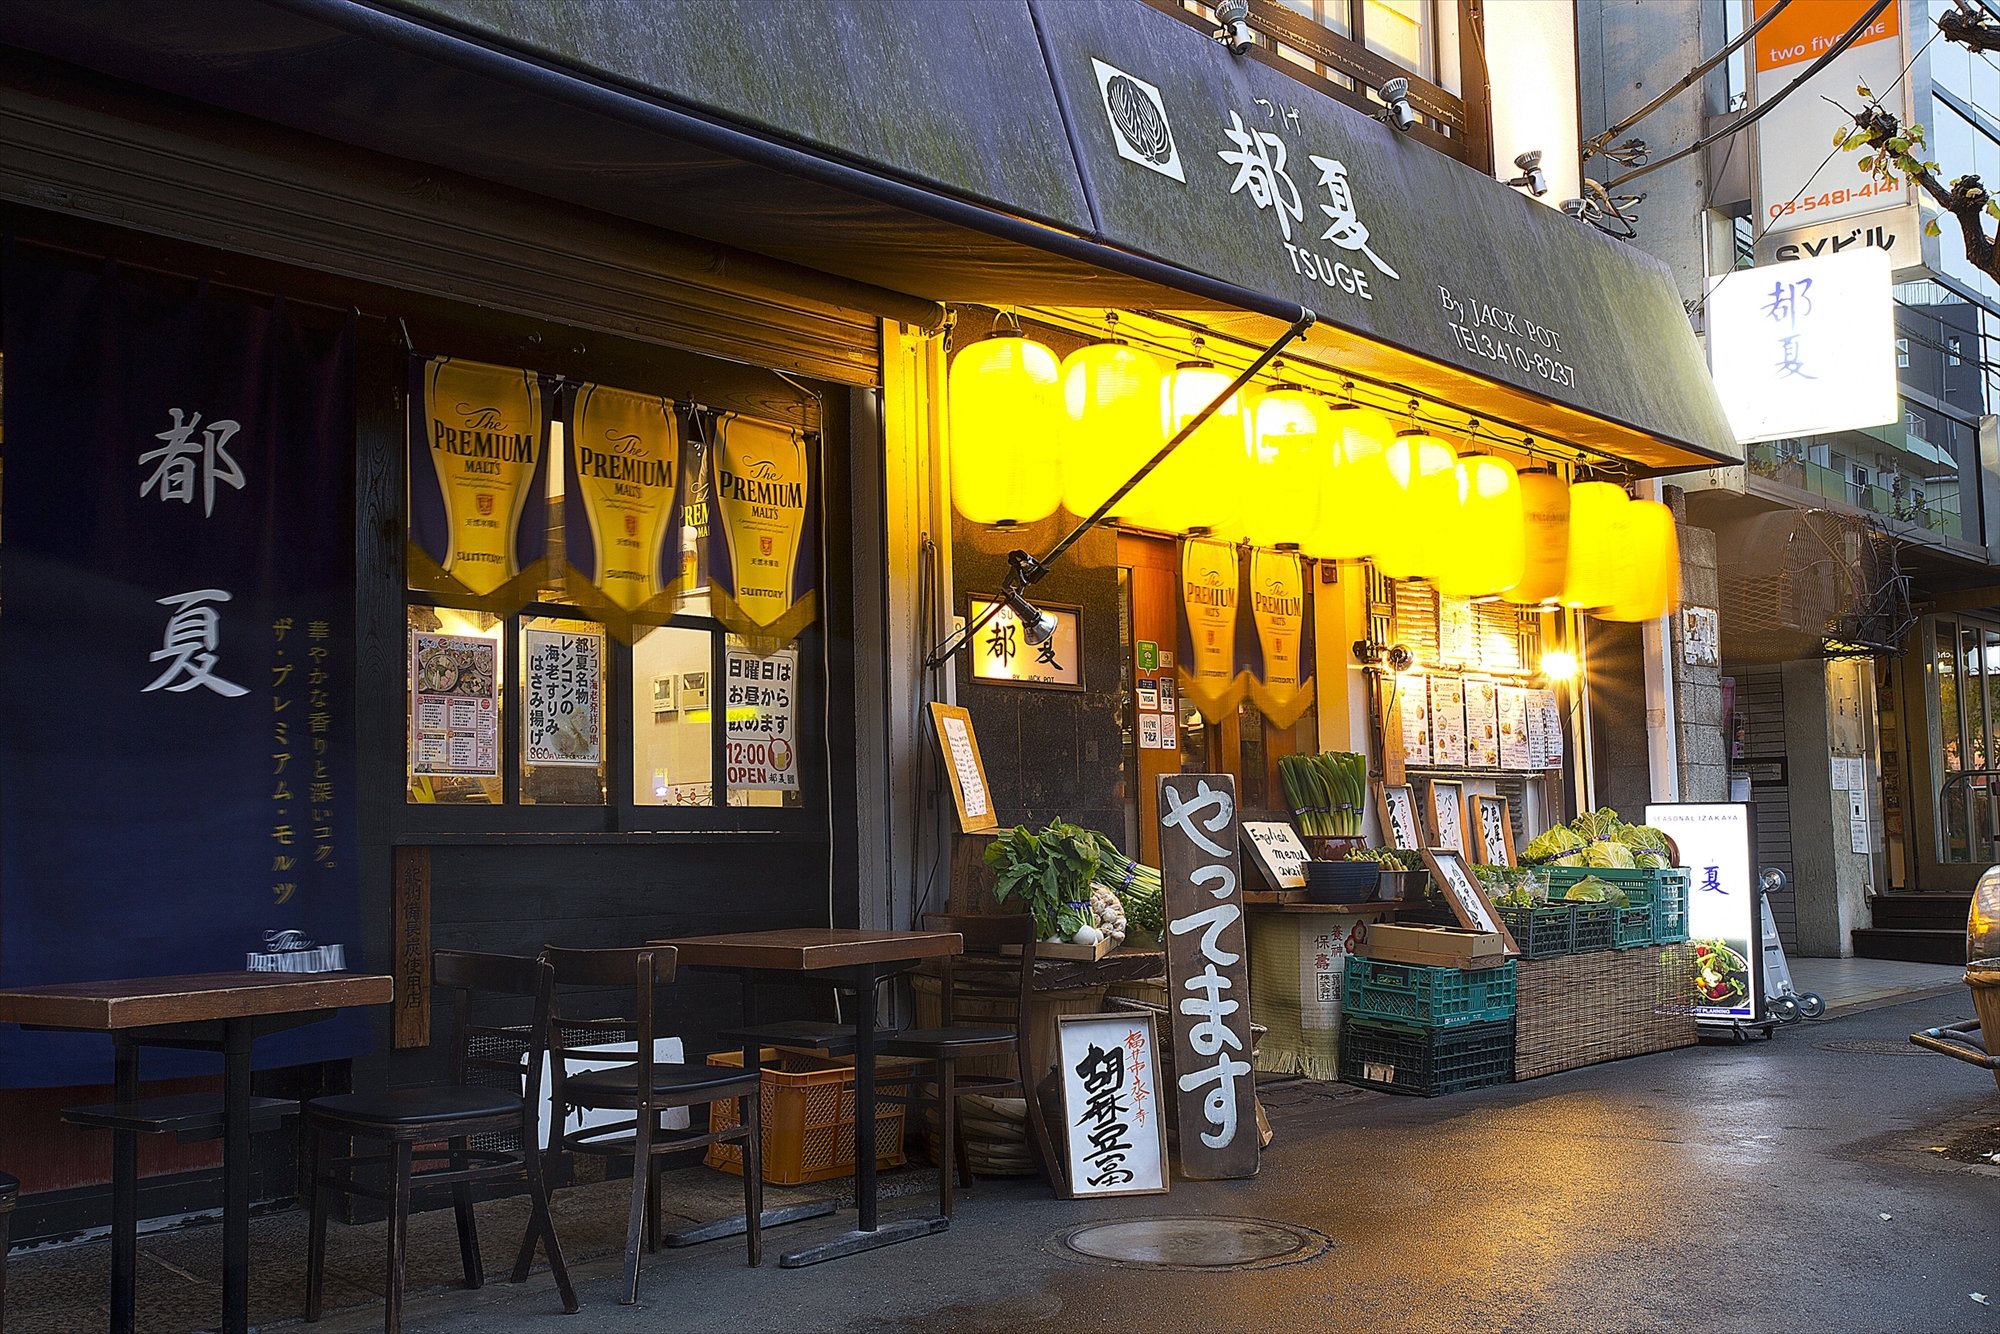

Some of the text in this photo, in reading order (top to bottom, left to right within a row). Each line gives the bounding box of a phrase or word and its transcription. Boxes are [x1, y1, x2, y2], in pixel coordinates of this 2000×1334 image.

[1769, 45, 1805, 62] two
[1857, 22, 1885, 41] ne
[1253, 97, 1302, 137] つげ
[1217, 109, 1400, 280] 都夏
[1769, 176, 1899, 218] 03-5481-4141
[1283, 246, 1373, 301] TSUGE
[1437, 290, 1573, 358] By JACK POT
[1760, 276, 1819, 380] 都夏
[1447, 326, 1586, 388] TEL3410-8237
[456, 403, 509, 431] The
[433, 418, 535, 464] PREMIUM
[605, 429, 651, 458] The
[580, 446, 674, 488] PREMIUM
[743, 455, 783, 481] The
[720, 470, 804, 508] PREMIUM
[138, 407, 251, 698] 都夏
[740, 587, 784, 599] SUNTORY
[1186, 582, 1237, 609] PREMIUM
[1200, 567, 1225, 587] The
[1265, 577, 1290, 598] The
[1255, 591, 1302, 617] PREMIUM
[560, 635, 574, 716] レンコンの
[575, 637, 589, 706] 都夏名物
[729, 658, 792, 681] 日曜日は
[529, 654, 545, 746] はさみ揚げ
[545, 644, 560, 736] 海老すりみ
[729, 684, 791, 708] お昼から
[1143, 695, 1154, 703] VISA
[728, 711, 789, 734] 飲めます
[272, 617, 297, 905] ザ・プレミアム・モルツ
[307, 620, 338, 868] 華やかな香りと深いコク。
[727, 743, 766, 765] 12:00
[728, 767, 768, 784] OPEN
[1250, 827, 1290, 846] English
[1698, 814, 1739, 822] IZAKAYA
[1272, 850, 1308, 862] menu
[1162, 779, 1252, 1150] やってます
